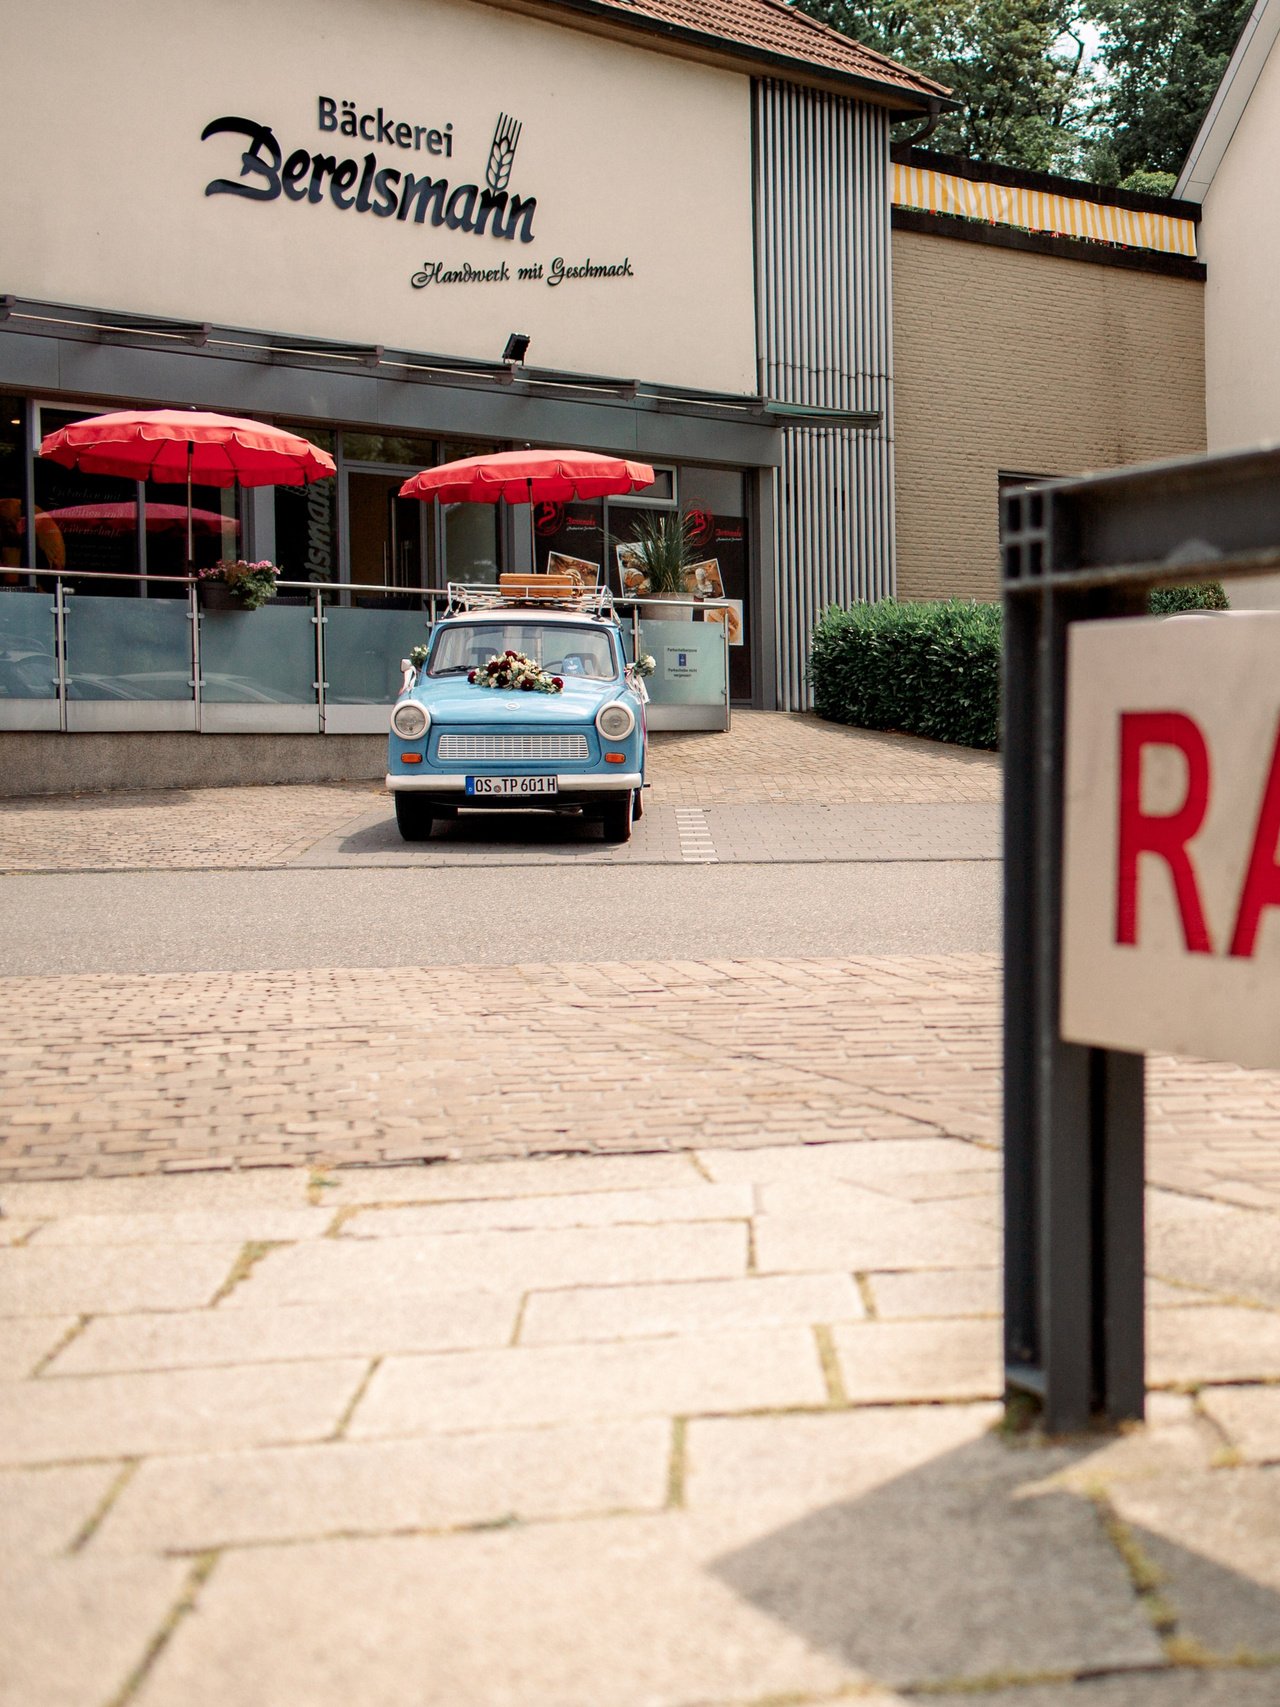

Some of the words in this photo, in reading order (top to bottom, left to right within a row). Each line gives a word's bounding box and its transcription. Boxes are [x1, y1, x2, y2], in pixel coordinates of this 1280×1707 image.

[318, 95, 454, 158] Bäckerei
[200, 116, 538, 244] Berelsmann
[410, 260, 511, 289] Handwerk
[517, 262, 544, 280] mit
[475, 778, 492, 793] OS
[501, 778, 518, 793] TP
